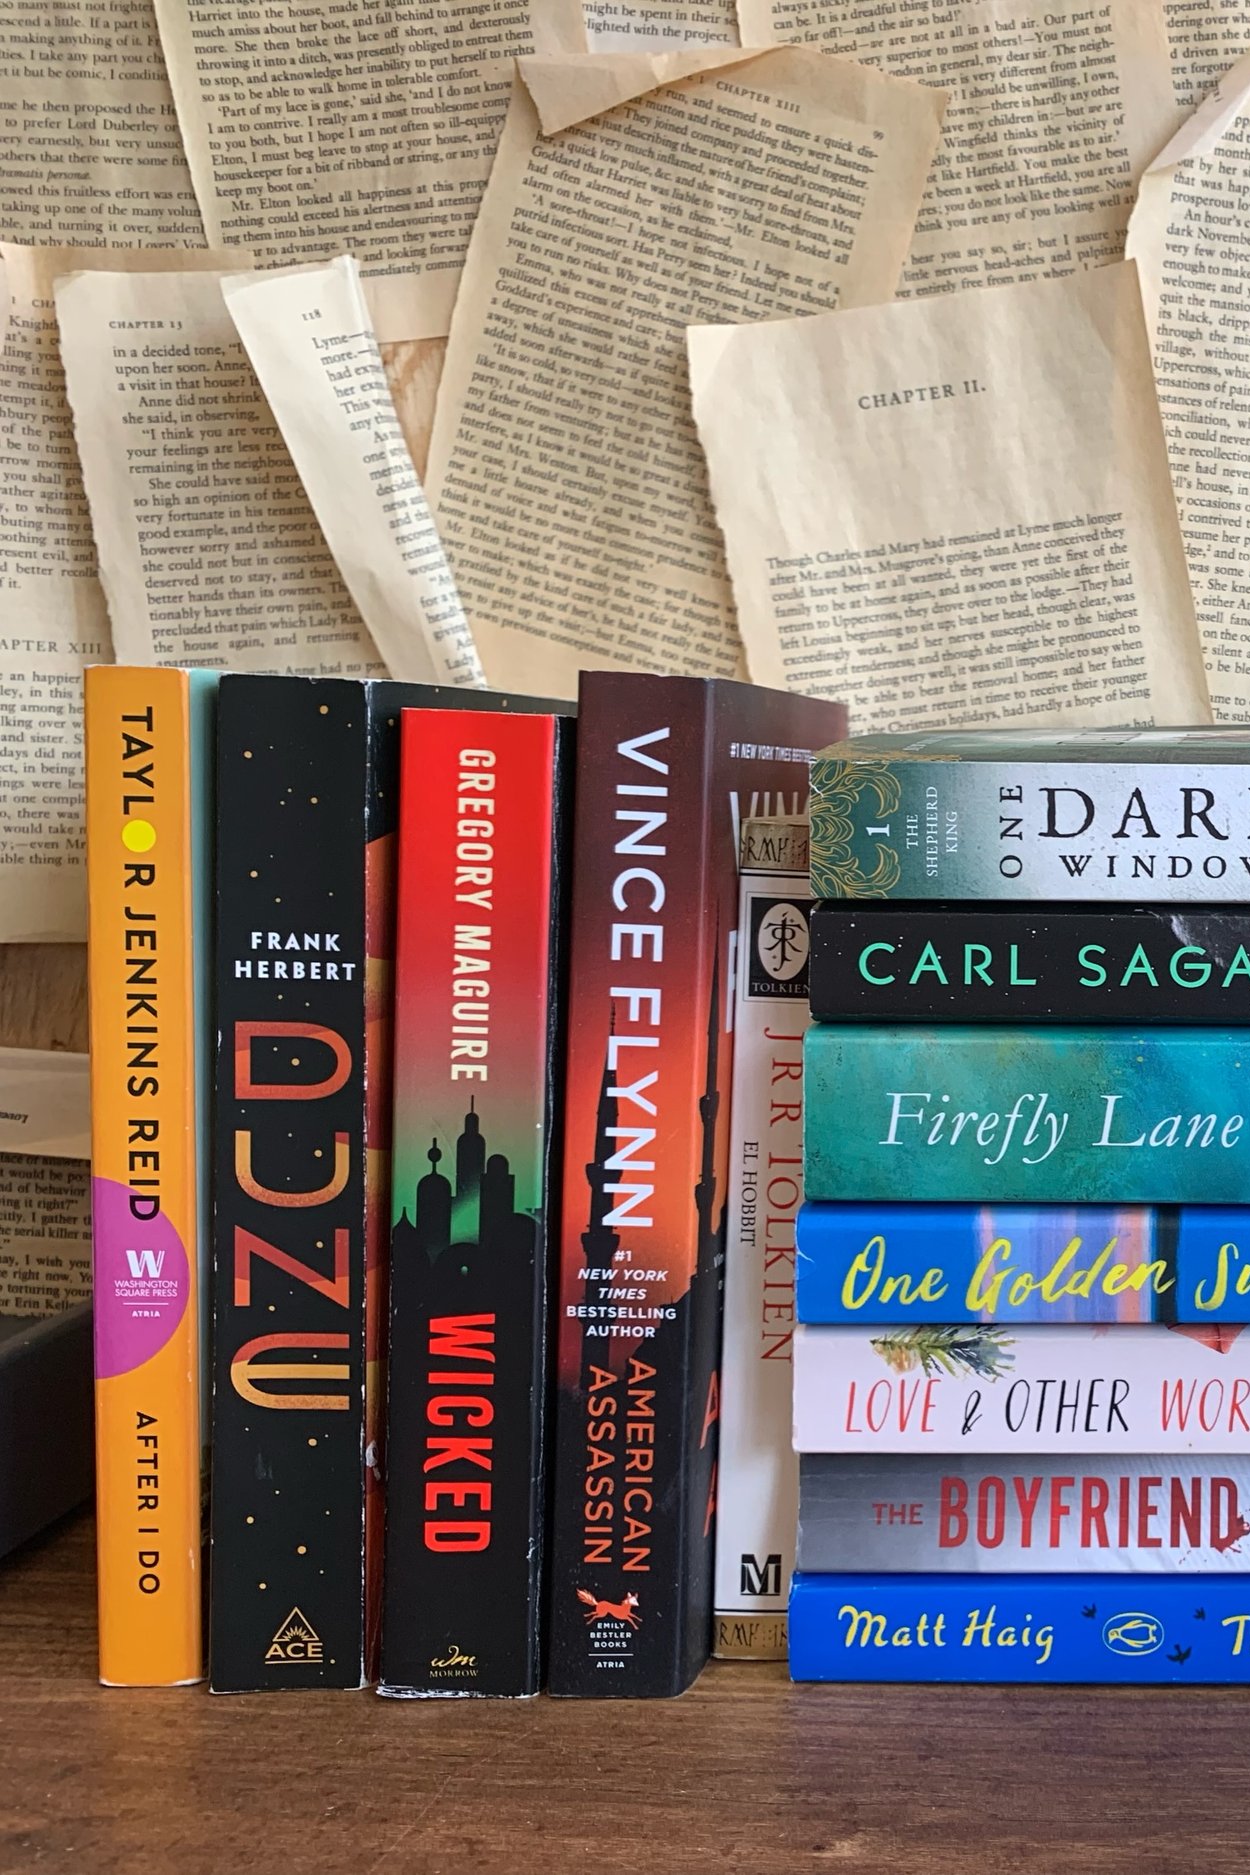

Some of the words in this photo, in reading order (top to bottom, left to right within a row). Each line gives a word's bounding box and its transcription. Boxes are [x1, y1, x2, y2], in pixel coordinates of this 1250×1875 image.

[716, 81, 770, 105] CHAPTER
[216, 184, 243, 199] keep
[246, 183, 264, 197] my
[268, 180, 293, 194] boot
[109, 320, 164, 329] CHAPTER
[858, 384, 955, 410] CHAPTER
[964, 379, 986, 394] II.
[455, 749, 496, 911] GREGORY
[611, 727, 671, 963] VINCE
[866, 825, 890, 837] 1
[907, 813, 918, 849] THE
[927, 786, 938, 877] SHEPHERD
[946, 810, 957, 853] KING
[999, 784, 1024, 878] ONE
[251, 931, 341, 952] FRANK
[858, 940, 1037, 986] CARL
[234, 960, 356, 981] HERBERT
[752, 982, 810, 993] TOLKIEN
[125, 907, 159, 1098] JENKINS
[450, 926, 492, 1082] MAGUIRE
[602, 985, 662, 1227] FLYNN
[879, 1093, 1070, 1164] Firefly
[1092, 1095, 1244, 1148] Lane
[128, 1119, 160, 1222] REID
[743, 1142, 759, 1164] EL
[230, 1021, 352, 1410] DUNE
[740, 1170, 758, 1247] HOBBIT
[577, 1267, 618, 1281] NEW
[622, 1267, 669, 1281] YORK
[614, 1250, 632, 1262] #1
[760, 1144, 804, 1363] TOLKIEN
[841, 1236, 949, 1309] One
[966, 1237, 1176, 1314] Golden
[115, 1279, 178, 1288] WASHINGTON
[115, 1288, 148, 1297] SQUARE
[151, 1288, 178, 1297] PRESS
[598, 1288, 647, 1300] TIMES
[132, 1310, 161, 1318] ATRIA
[566, 1306, 677, 1320] BESTSELLING
[586, 1325, 656, 1338] AUTHOR
[845, 1379, 941, 1434] LOVE
[960, 1390, 982, 1435] &
[1005, 1379, 1130, 1433] OTHER
[423, 1313, 495, 1553] WICKED
[136, 1411, 158, 1512] AFTER
[583, 1365, 617, 1564] ASSASSIN
[622, 1358, 657, 1572] AMERICAN
[872, 1503, 923, 1525] THE
[138, 1551, 160, 1595] DO
[265, 1643, 323, 1658] ACE
[838, 1605, 946, 1648] Matt
[961, 1605, 1054, 1665] Haig
[429, 1669, 479, 1678] MORROW
